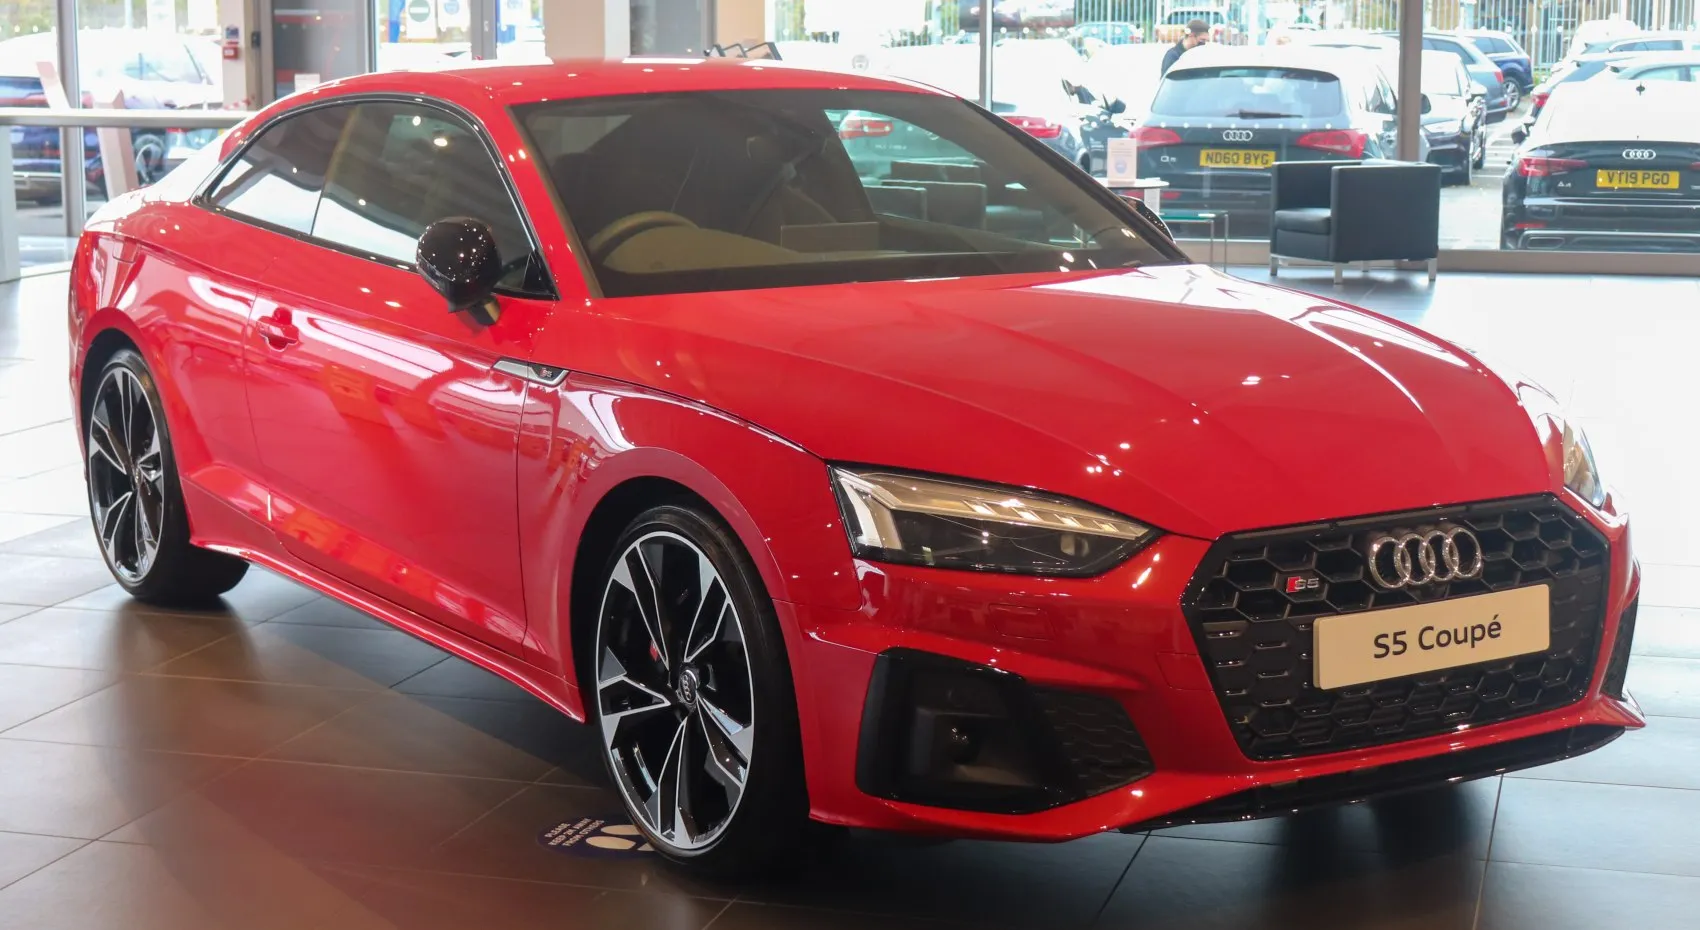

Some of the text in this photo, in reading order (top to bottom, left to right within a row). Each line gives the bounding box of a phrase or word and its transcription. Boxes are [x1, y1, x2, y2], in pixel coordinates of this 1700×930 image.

[1206, 151, 1269, 165] ND60 BYG
[1607, 171, 1670, 185] VT19 PGO
[1373, 614, 1502, 659] S5 Coupé
